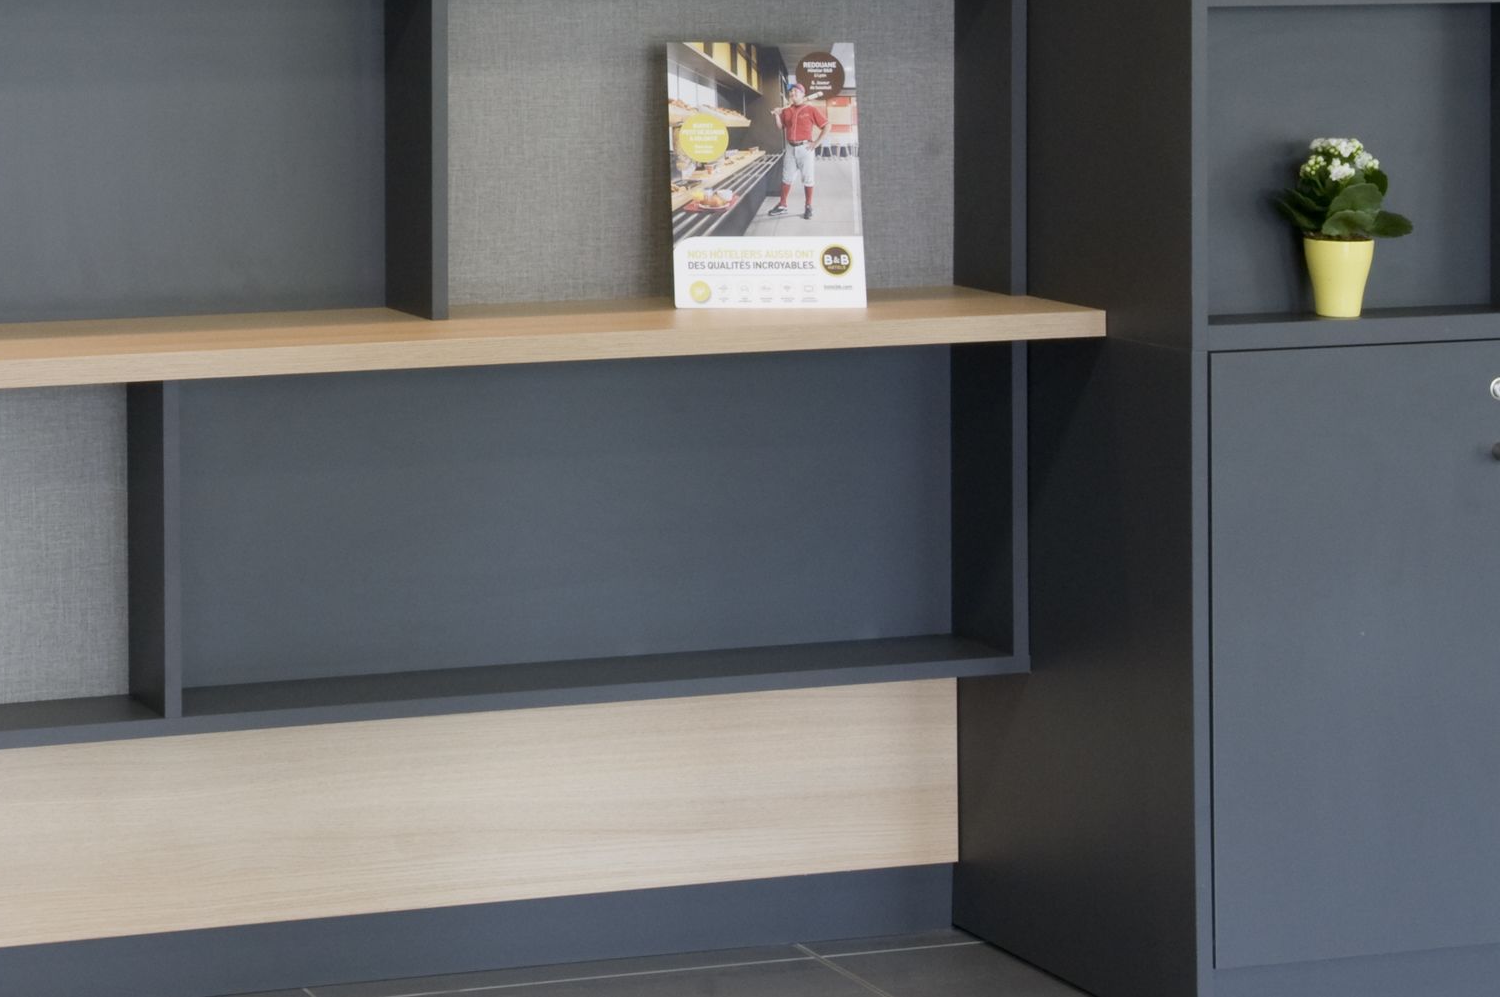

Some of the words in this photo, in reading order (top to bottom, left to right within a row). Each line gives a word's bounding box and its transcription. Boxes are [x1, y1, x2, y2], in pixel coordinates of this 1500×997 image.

[688, 251, 708, 259] NOS
[709, 248, 763, 259] HÔTELIERS
[765, 250, 793, 259] AUSSI
[794, 250, 814, 258] ONT
[824, 254, 850, 264] B&B
[688, 261, 706, 270] DES
[707, 259, 751, 270] QUALITÉS
[752, 261, 816, 270] INCROYABLES.
